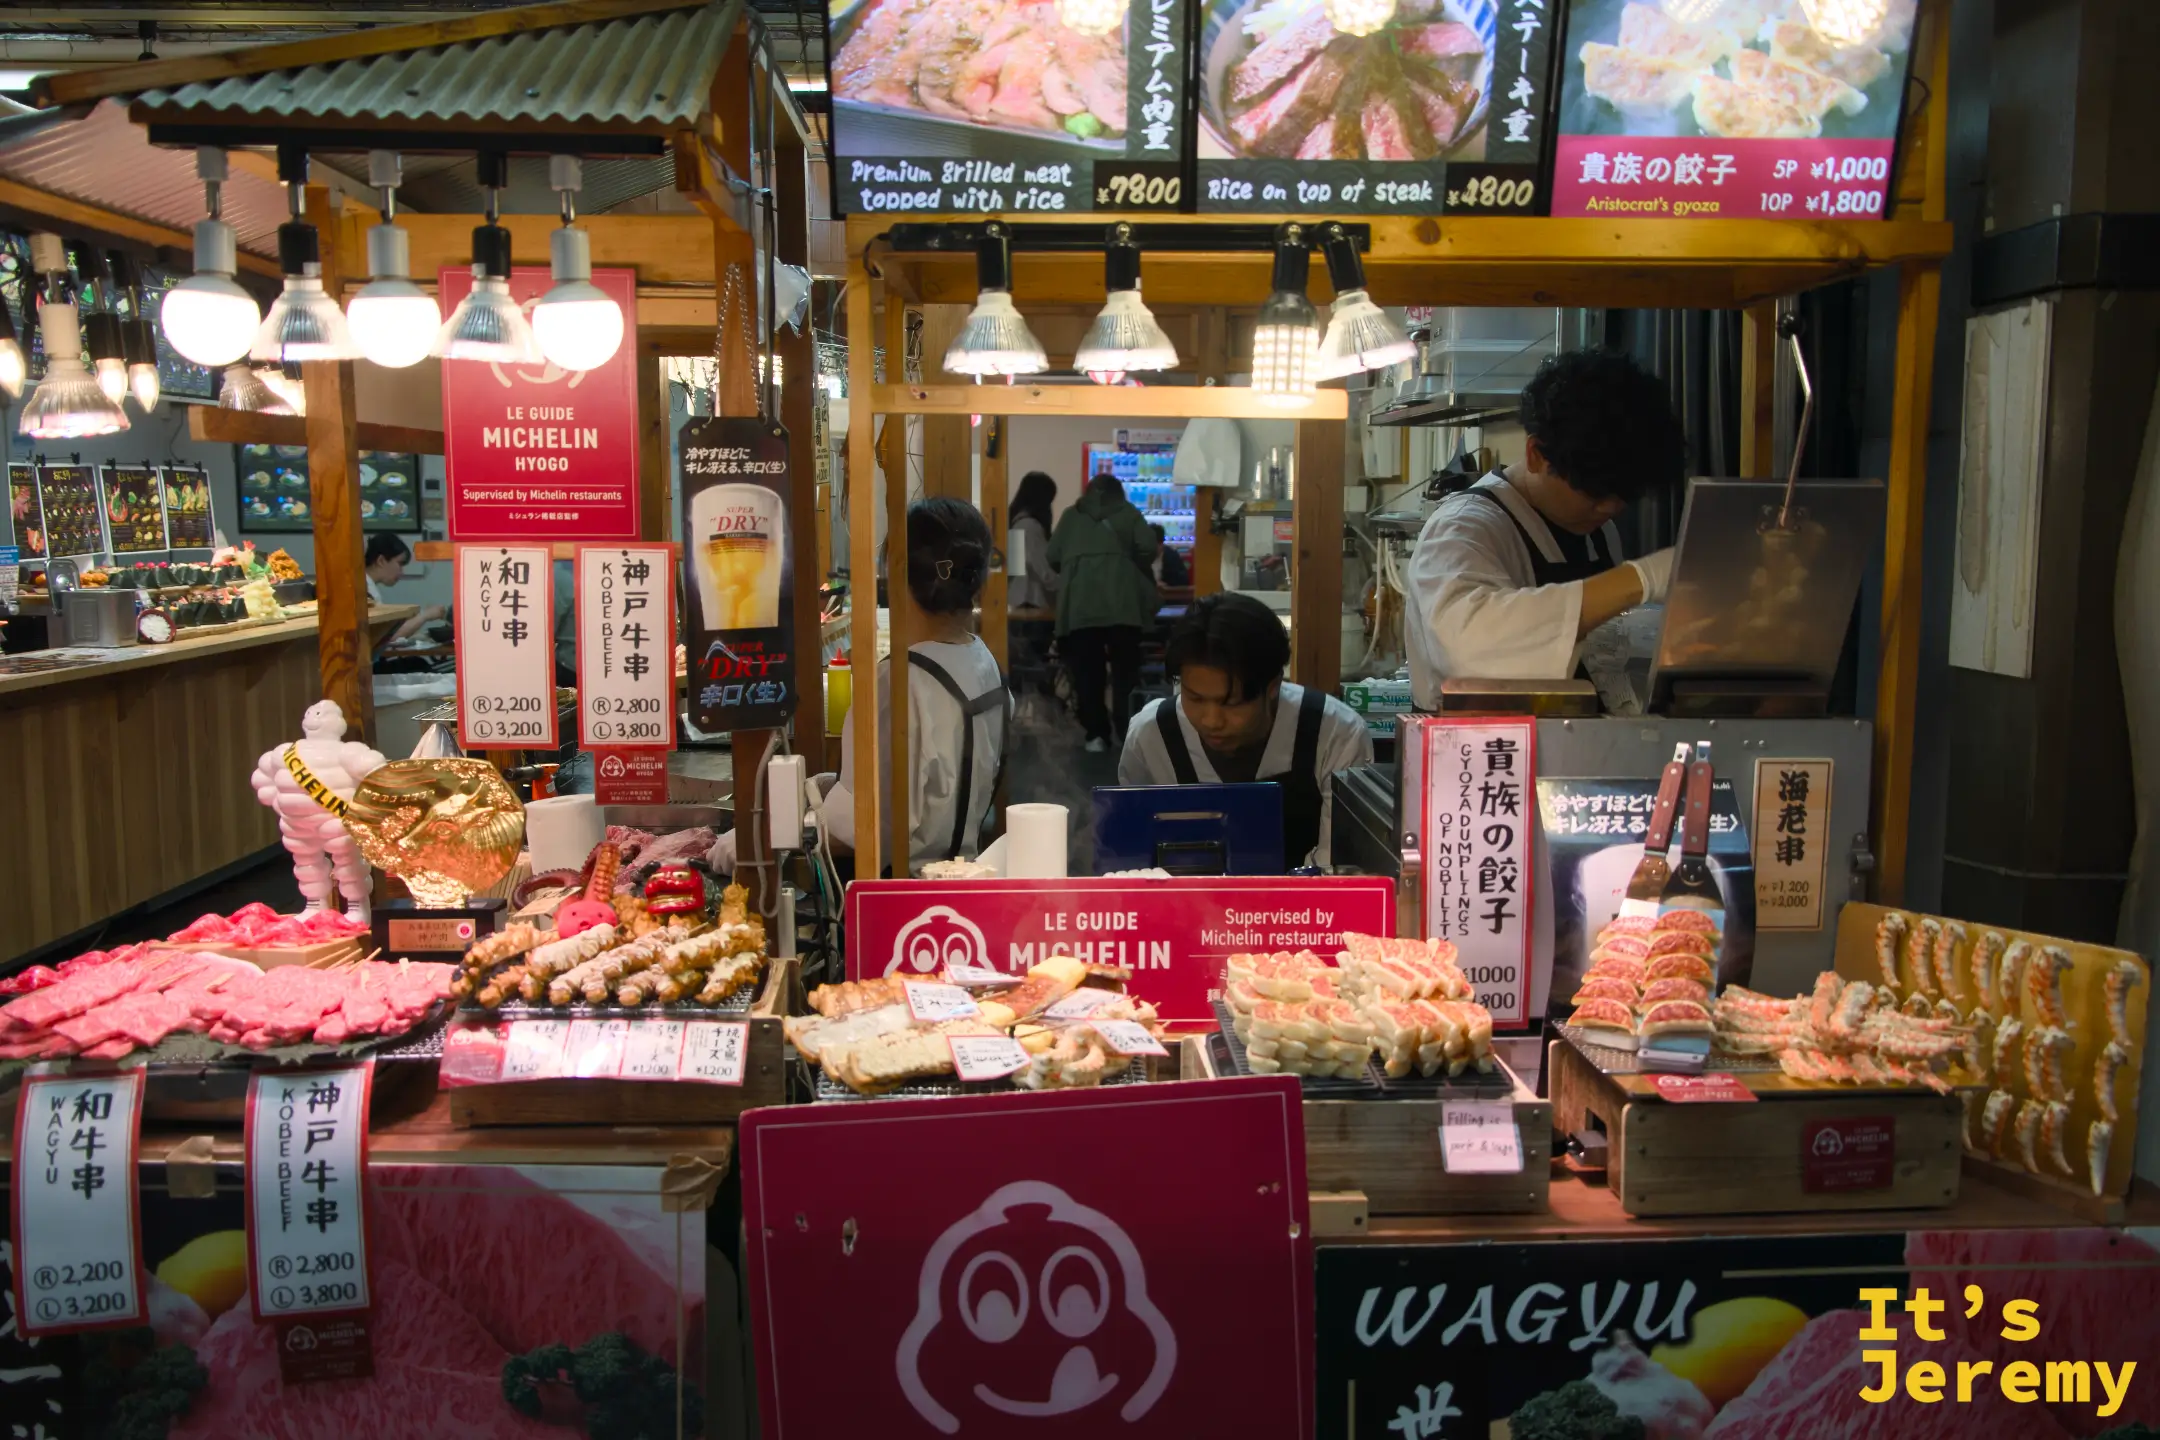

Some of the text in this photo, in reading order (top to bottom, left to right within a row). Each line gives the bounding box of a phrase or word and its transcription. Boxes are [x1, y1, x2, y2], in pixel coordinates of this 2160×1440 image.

[852, 161, 1072, 187] Premium grilled meat
[1579, 152, 1737, 185] 貴族の餃子
[1773, 157, 1888, 180] 5P ¥1,000
[860, 187, 1064, 210] topped with rice
[1096, 173, 1180, 204] ¥7800
[1208, 178, 1433, 204] Rice on top of steak
[1446, 175, 1534, 206] ¥4800
[1586, 196, 1720, 215] Aristocrat's gyoza
[1761, 190, 1881, 214] 10P ¥1,800
[507, 407, 574, 421] LE GUIDE
[483, 427, 598, 449] MICHELIN
[515, 457, 569, 471] HYOGO
[685, 447, 751, 460] 冷やすほどに
[463, 488, 622, 502] Supervised by Michelin restaurants
[726, 506, 754, 514] SUPER
[480, 561, 492, 632] WAGYU
[499, 558, 530, 647] 和牛串
[601, 562, 613, 679] KOBE BEEF
[620, 558, 650, 682] 神戸牛串
[494, 697, 541, 714] 2,200
[614, 697, 661, 715] 2,800
[1350, 690, 1362, 706] S
[497, 721, 542, 738] 3,200
[616, 721, 661, 738] 3,800
[626, 762, 663, 770] MICHELIN
[1775, 770, 1810, 867] 海老串
[1458, 743, 1473, 936] GYOZA DUMPLINGS
[1478, 737, 1521, 935] 貴族の餃子
[1439, 812, 1453, 941] OF NOBILIT
[1044, 912, 1138, 931] LE GUIDE
[1225, 908, 1334, 928] Supervised by
[1201, 931, 1344, 946] Michelin restauran
[1473, 992, 1515, 1010] 800
[1447, 1111, 1484, 1128] Filling
[45, 1096, 66, 1184] WAGYU
[70, 1089, 113, 1199] 和牛串
[278, 1088, 295, 1232] KOBE BEEF
[301, 1081, 341, 1233] 神戸牛串
[62, 1260, 123, 1286] 2,200
[296, 1252, 354, 1275] 2,800
[65, 1292, 126, 1316] 3,200
[299, 1282, 356, 1304] 3,800
[1354, 1278, 1698, 1353] WAGYU
